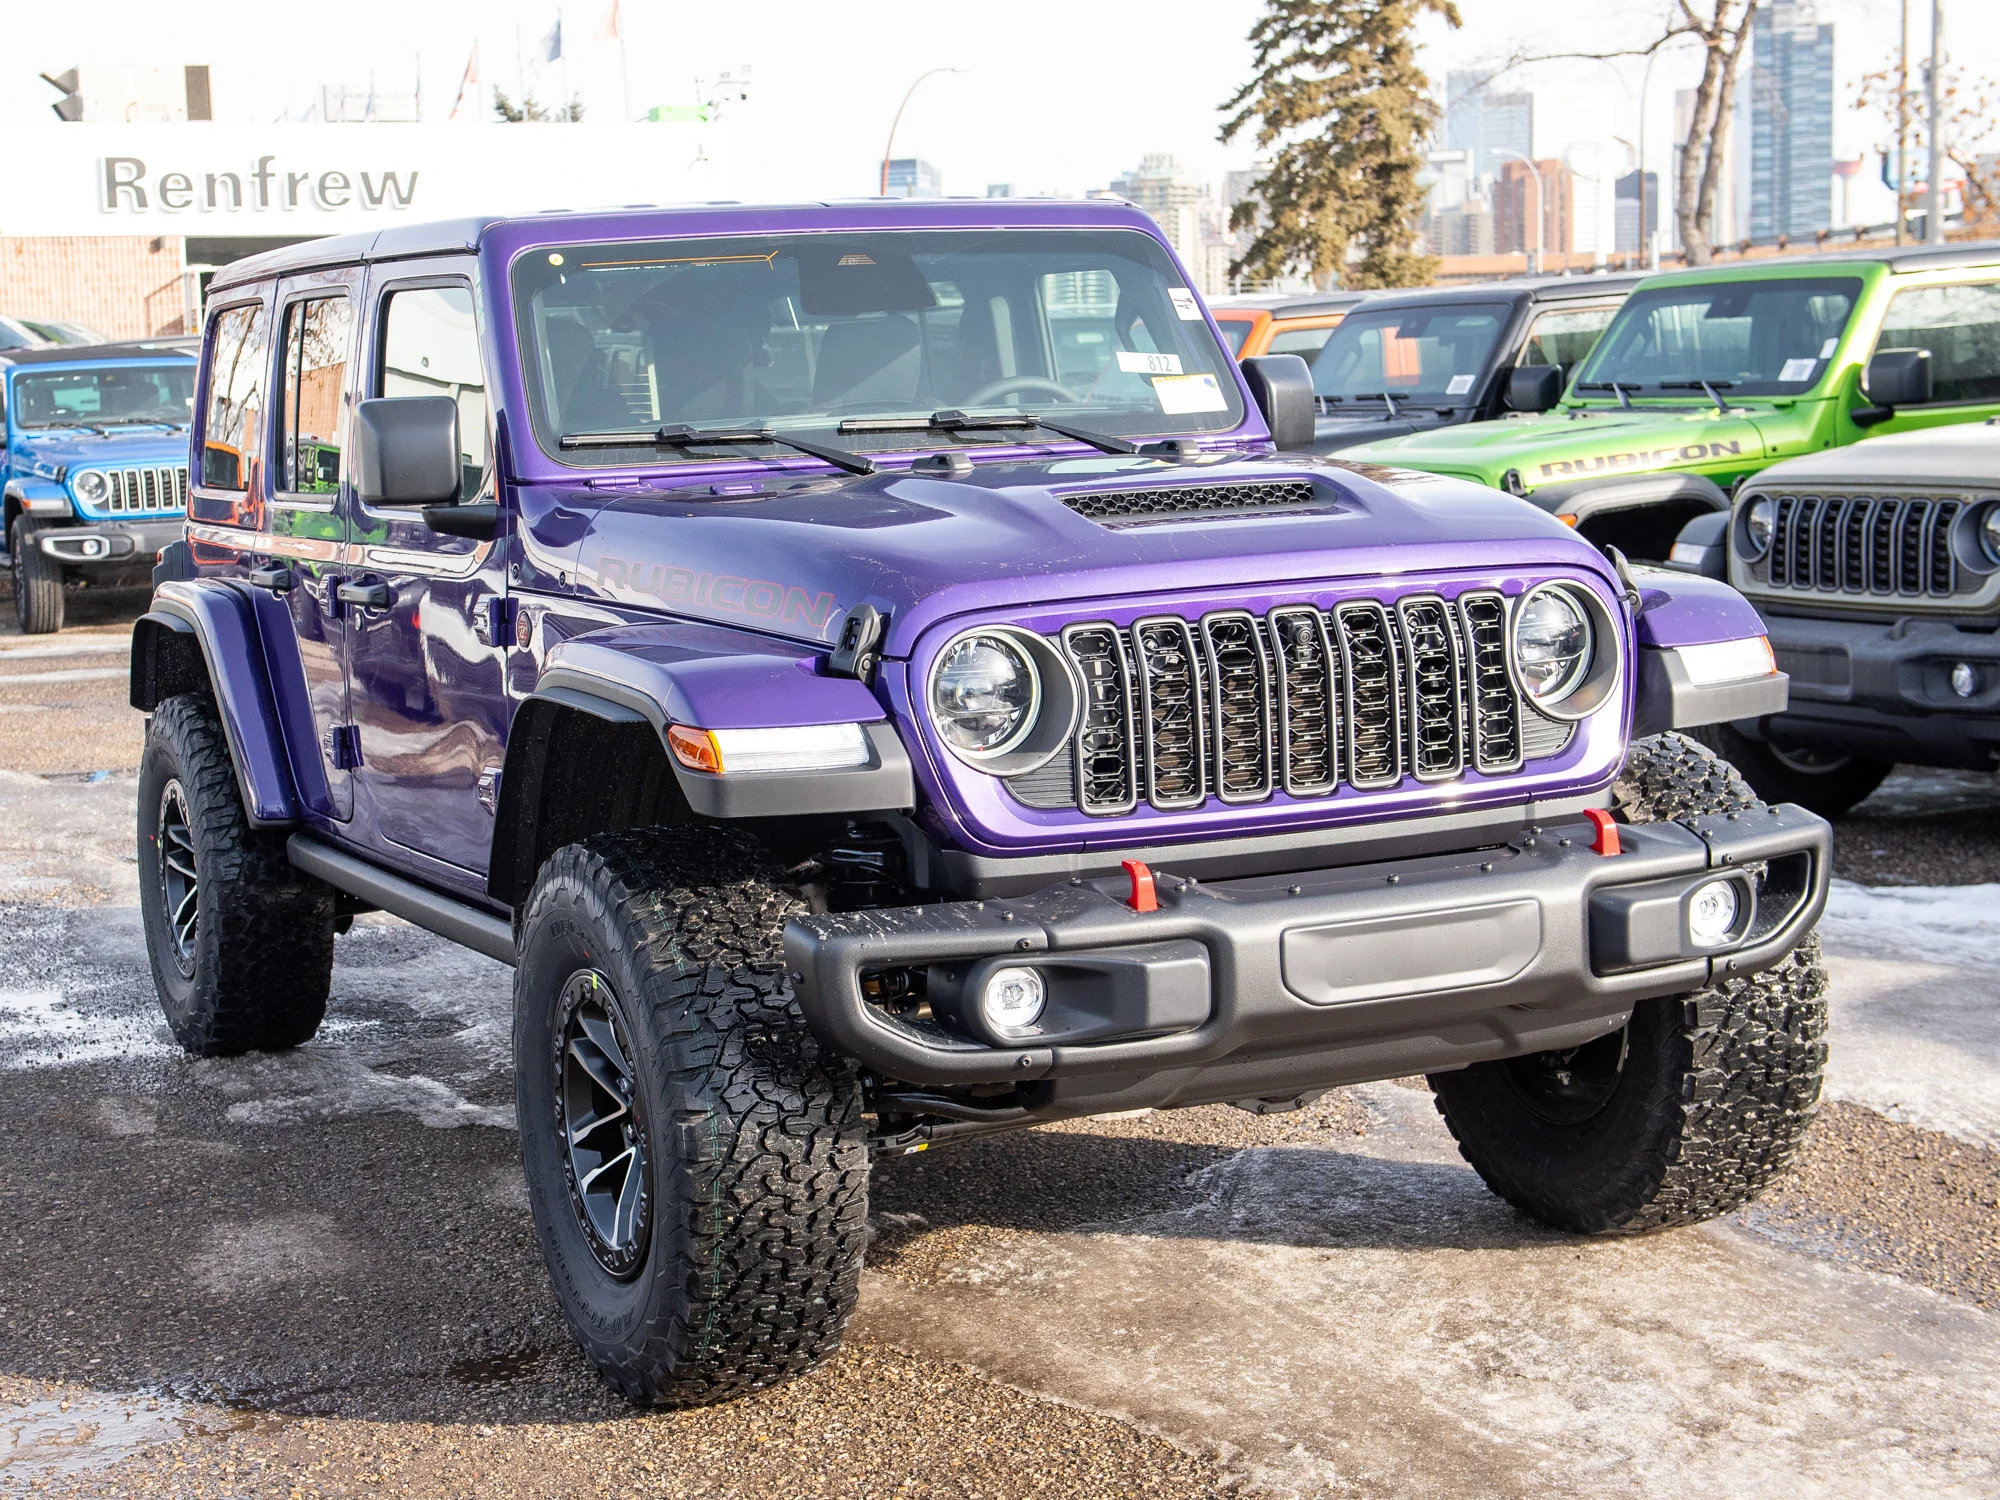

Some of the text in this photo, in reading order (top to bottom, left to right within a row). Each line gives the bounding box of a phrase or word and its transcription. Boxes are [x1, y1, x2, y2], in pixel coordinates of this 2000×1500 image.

[101, 155, 419, 211] Renfrew
[1148, 355, 1172, 372] 812
[1540, 441, 1742, 476] RUBICON
[598, 556, 835, 628] RUBICON
